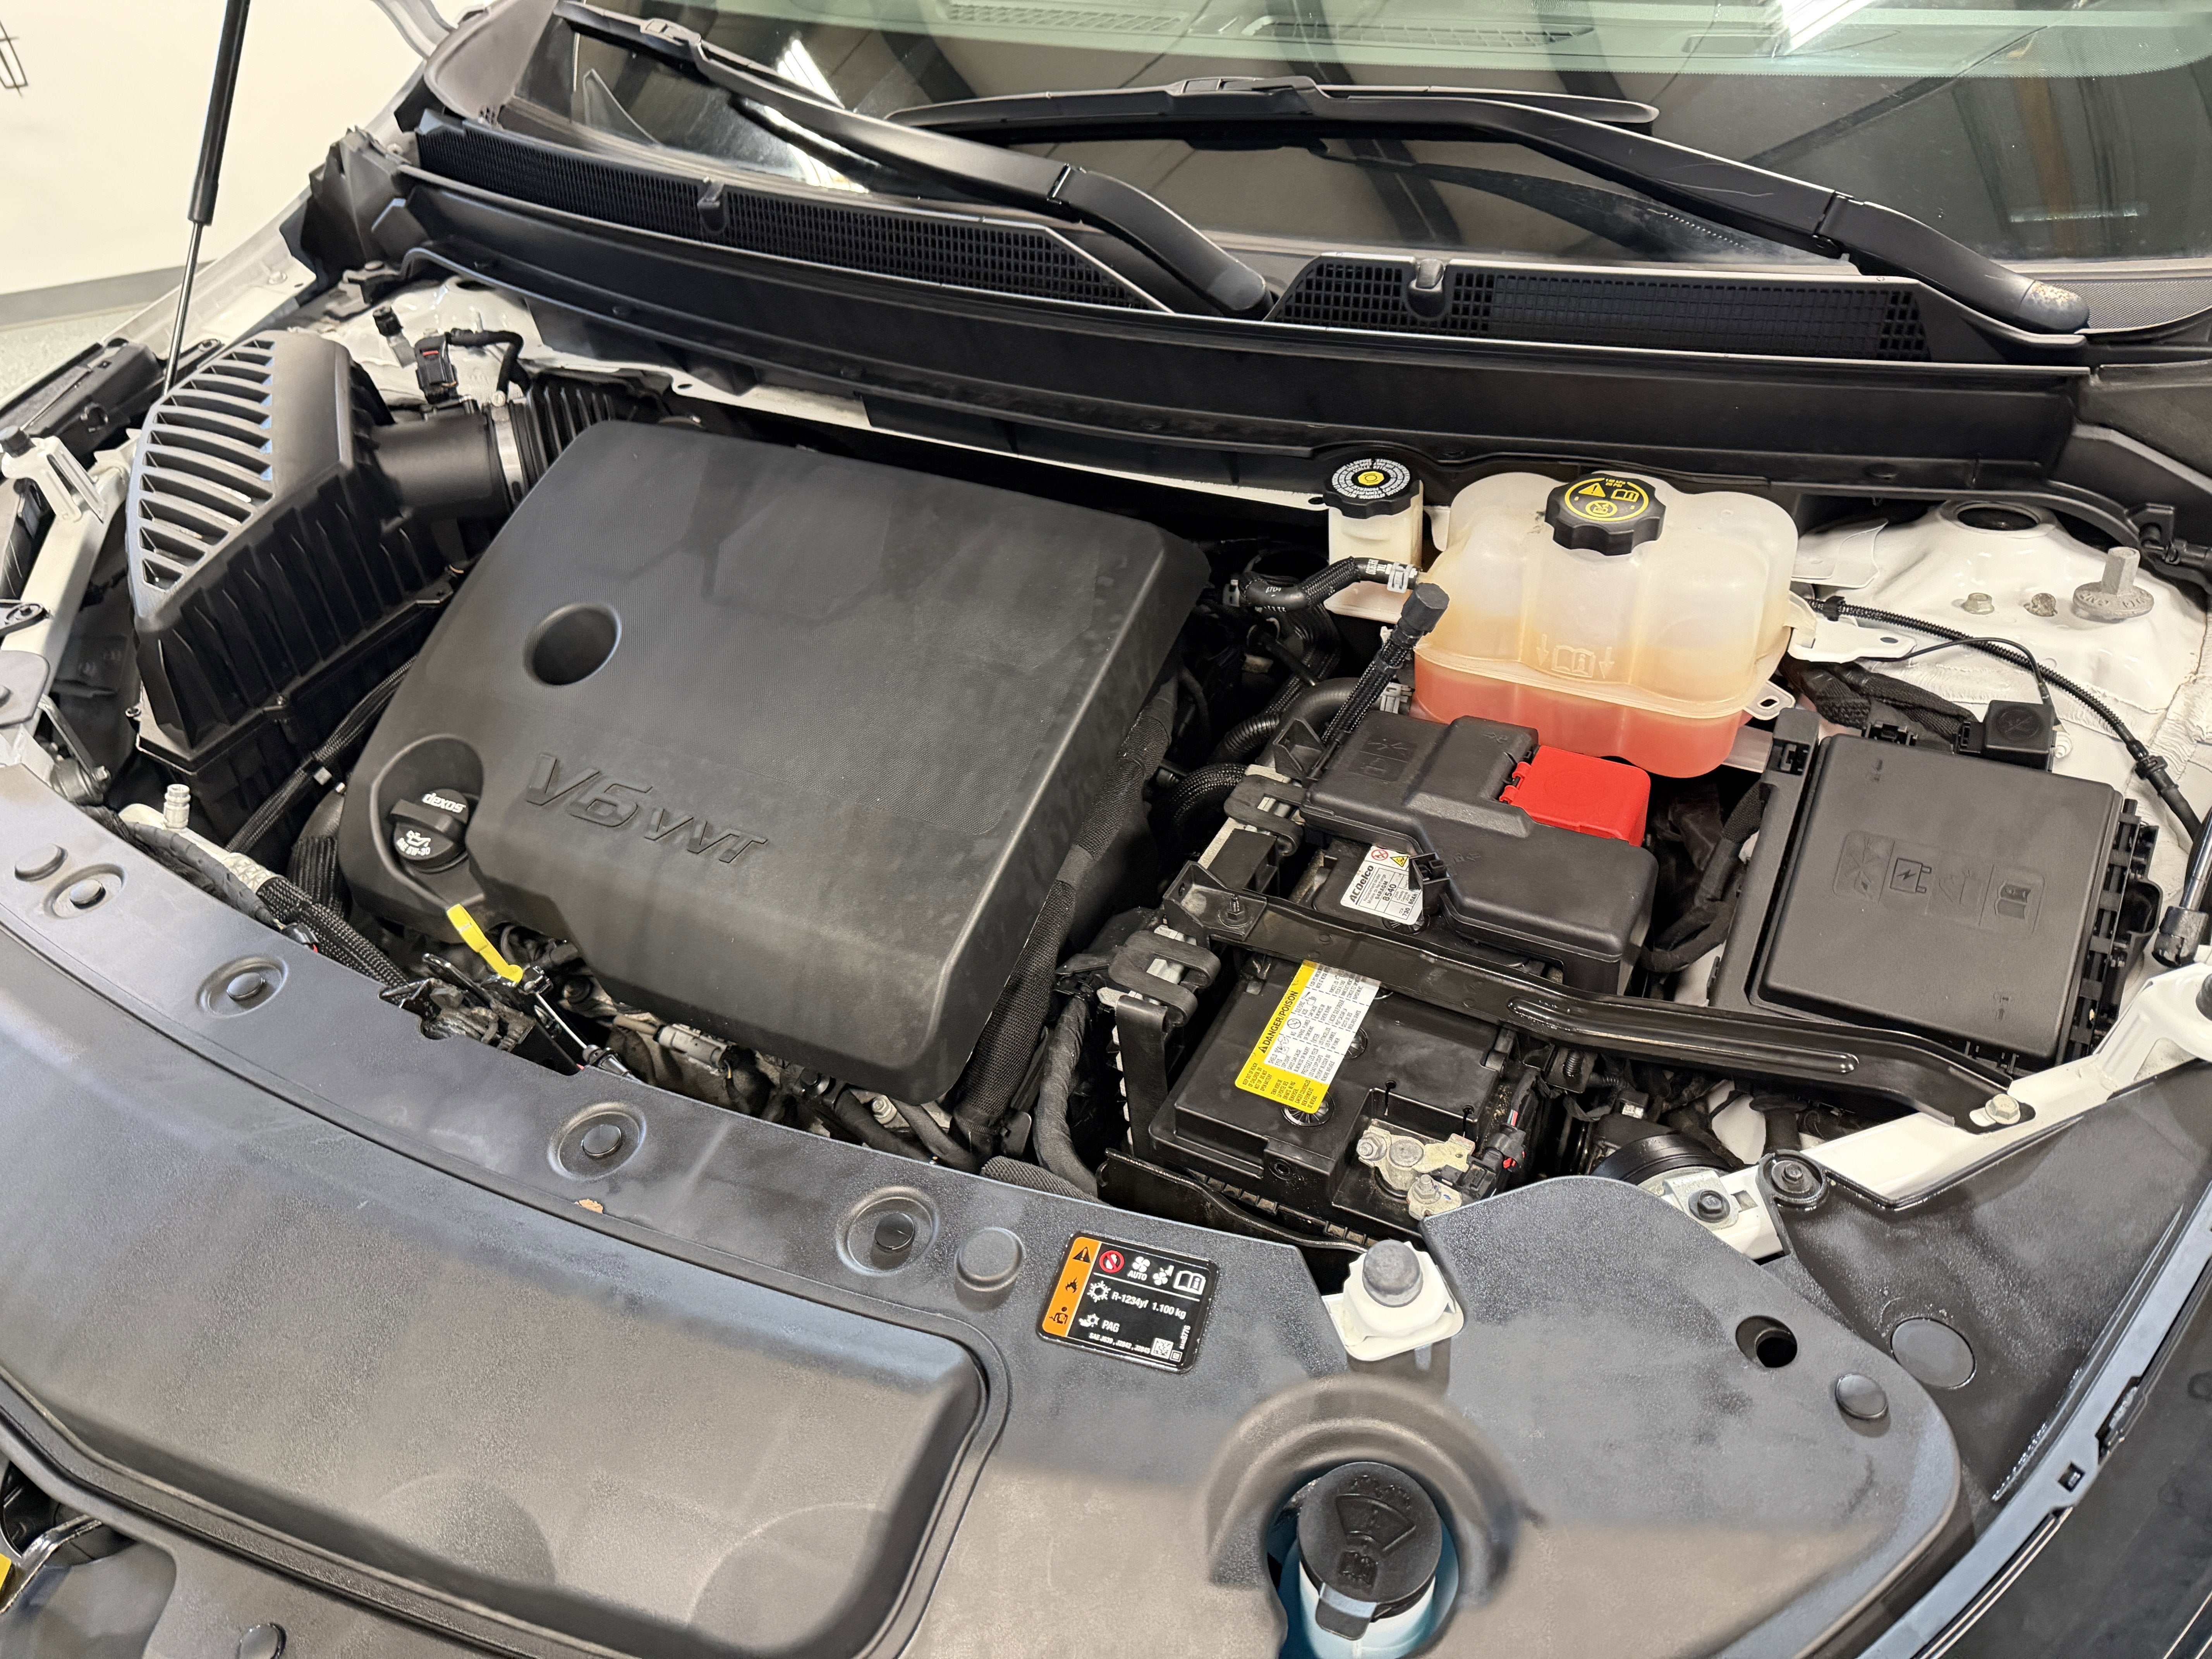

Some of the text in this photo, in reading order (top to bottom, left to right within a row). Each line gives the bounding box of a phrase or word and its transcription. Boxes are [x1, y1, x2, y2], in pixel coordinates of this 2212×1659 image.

[422, 793, 466, 813] dexos
[526, 754, 768, 863] V6 VVT
[1347, 864, 1374, 903] ACDelco
[1382, 883, 1397, 902] 8540
[1402, 907, 1410, 917] 730
[1262, 990, 1298, 1046] DANGER/POISON
[1128, 1270, 1147, 1281] AUTO
[1111, 1291, 1186, 1320] R-1234yf 1.100 kg
[1102, 1320, 1120, 1333] PAG
